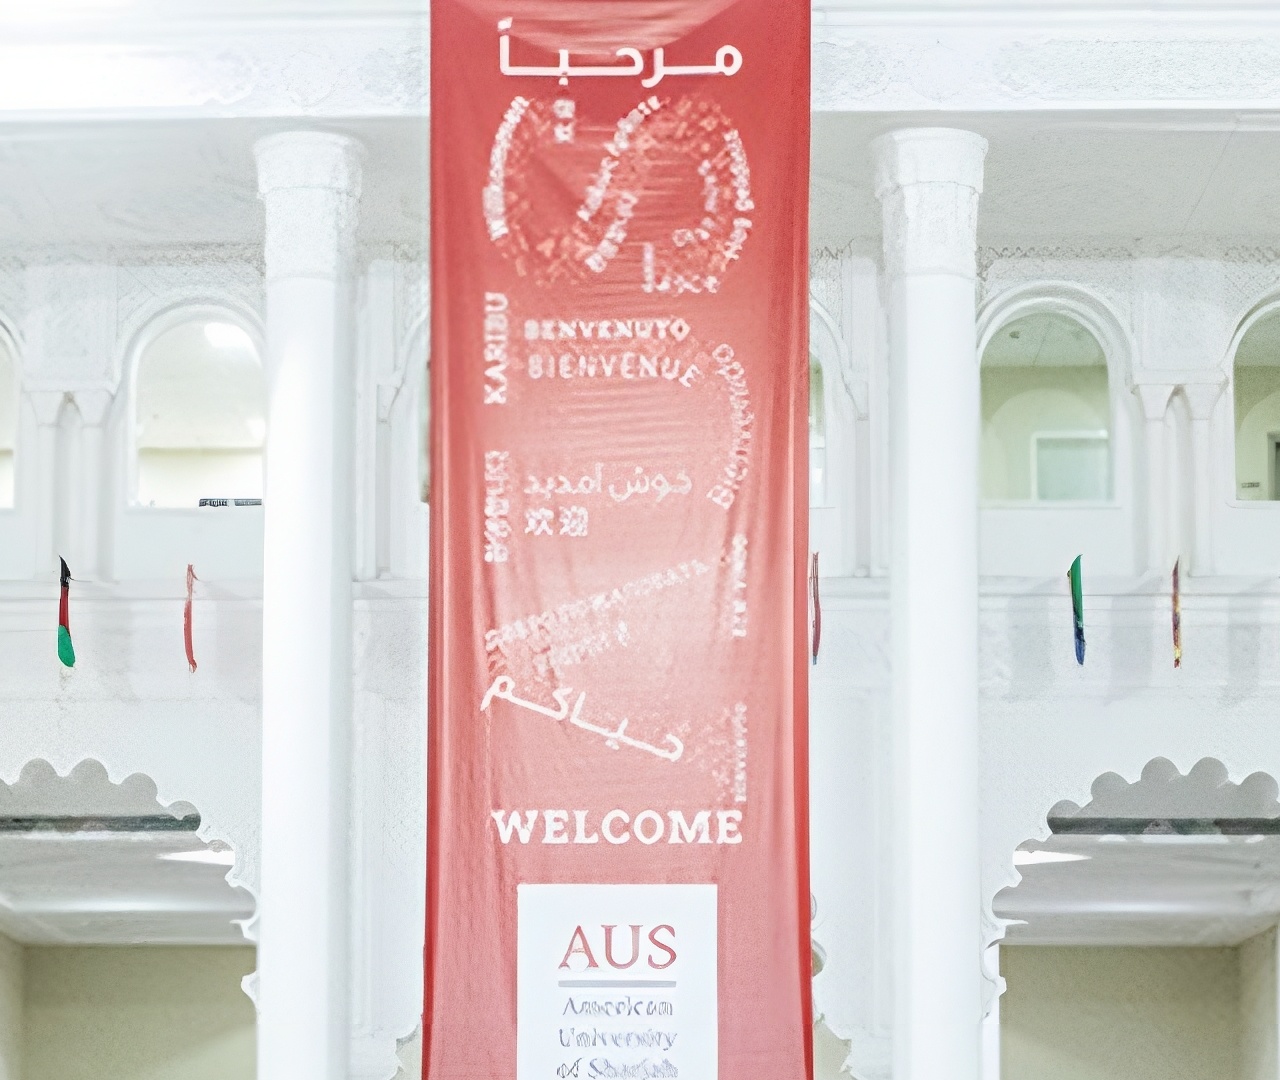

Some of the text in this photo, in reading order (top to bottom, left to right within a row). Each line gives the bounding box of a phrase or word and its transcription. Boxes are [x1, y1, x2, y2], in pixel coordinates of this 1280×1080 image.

[524, 318, 690, 342] BENVENUTO
[528, 351, 701, 387] BIENVENUE
[490, 808, 743, 845] WELCOME
[557, 924, 678, 970] AUS
